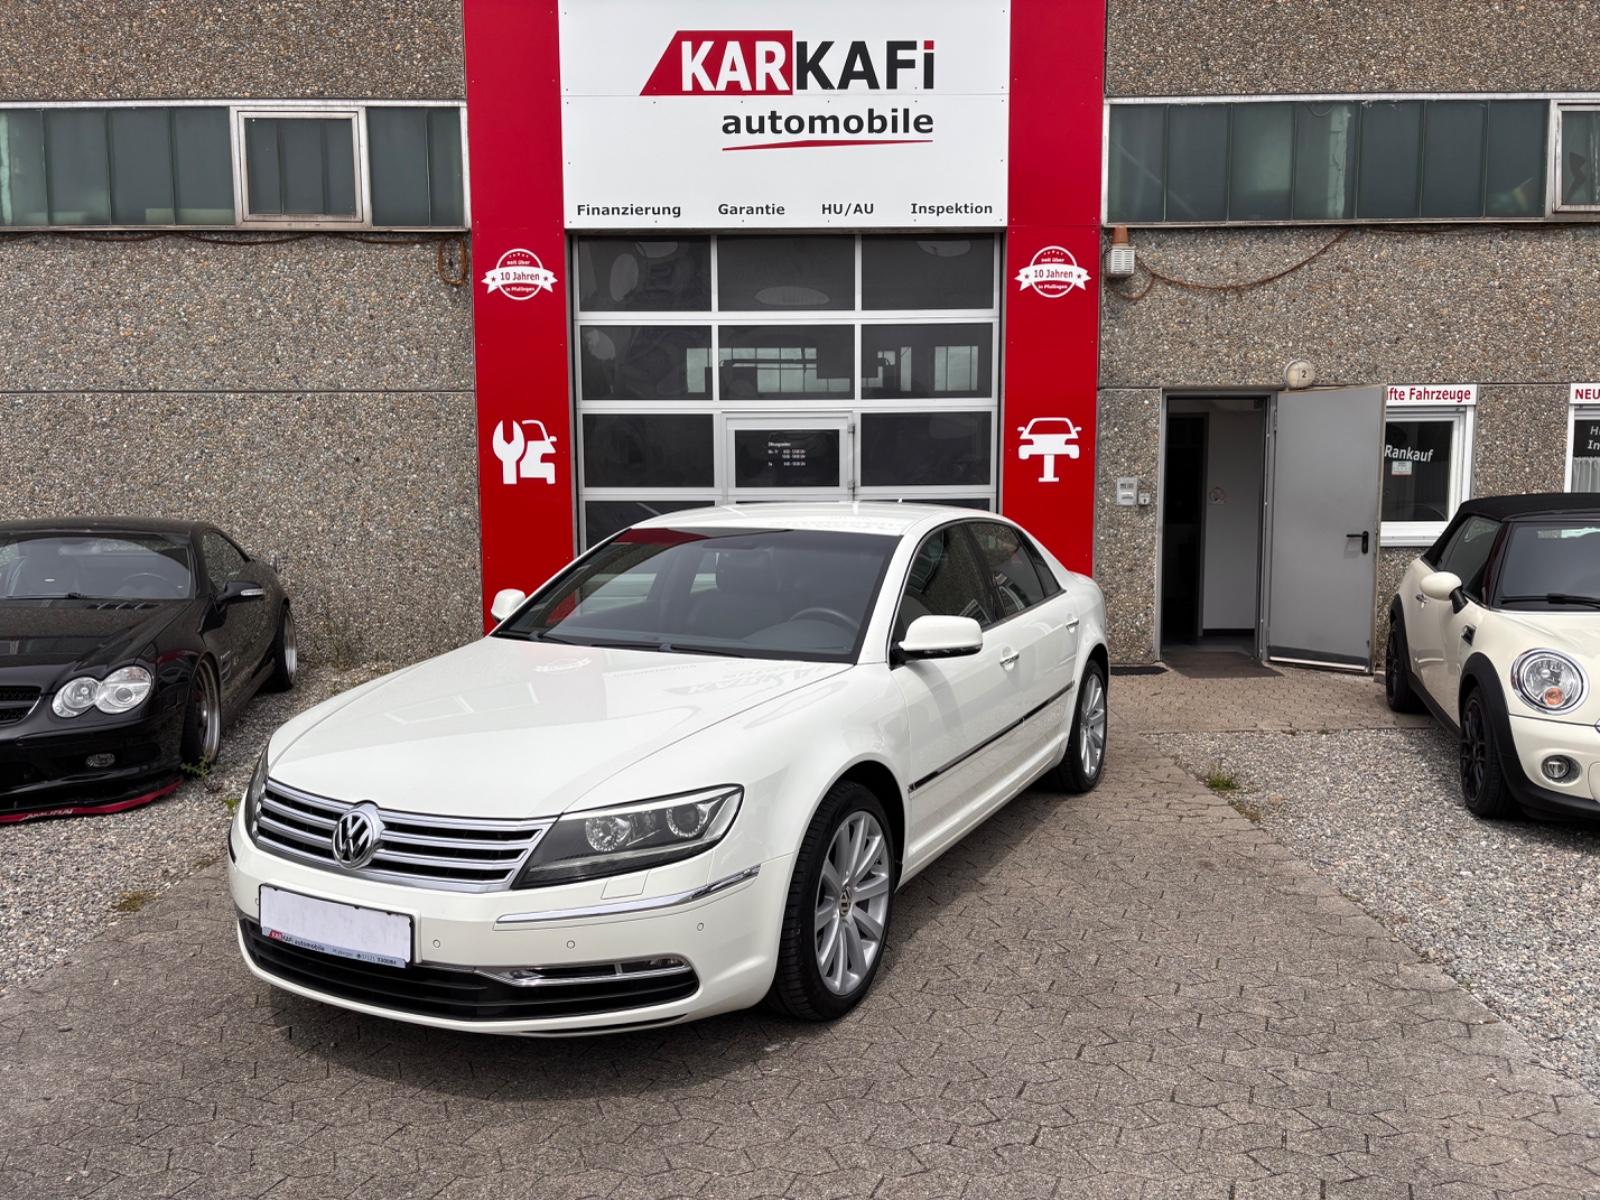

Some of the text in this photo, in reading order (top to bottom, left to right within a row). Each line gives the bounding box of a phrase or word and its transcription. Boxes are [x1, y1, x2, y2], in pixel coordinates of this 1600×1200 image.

[722, 108, 934, 135] automobile
[577, 202, 993, 218] Finanzierung Garantie HU/AU Inspektion
[501, 272, 540, 281] 10 Jahren
[1034, 269, 1073, 278] 10 Jahren
[1409, 387, 1471, 403] Fahrzeuge
[1384, 445, 1433, 462] Rankauf
